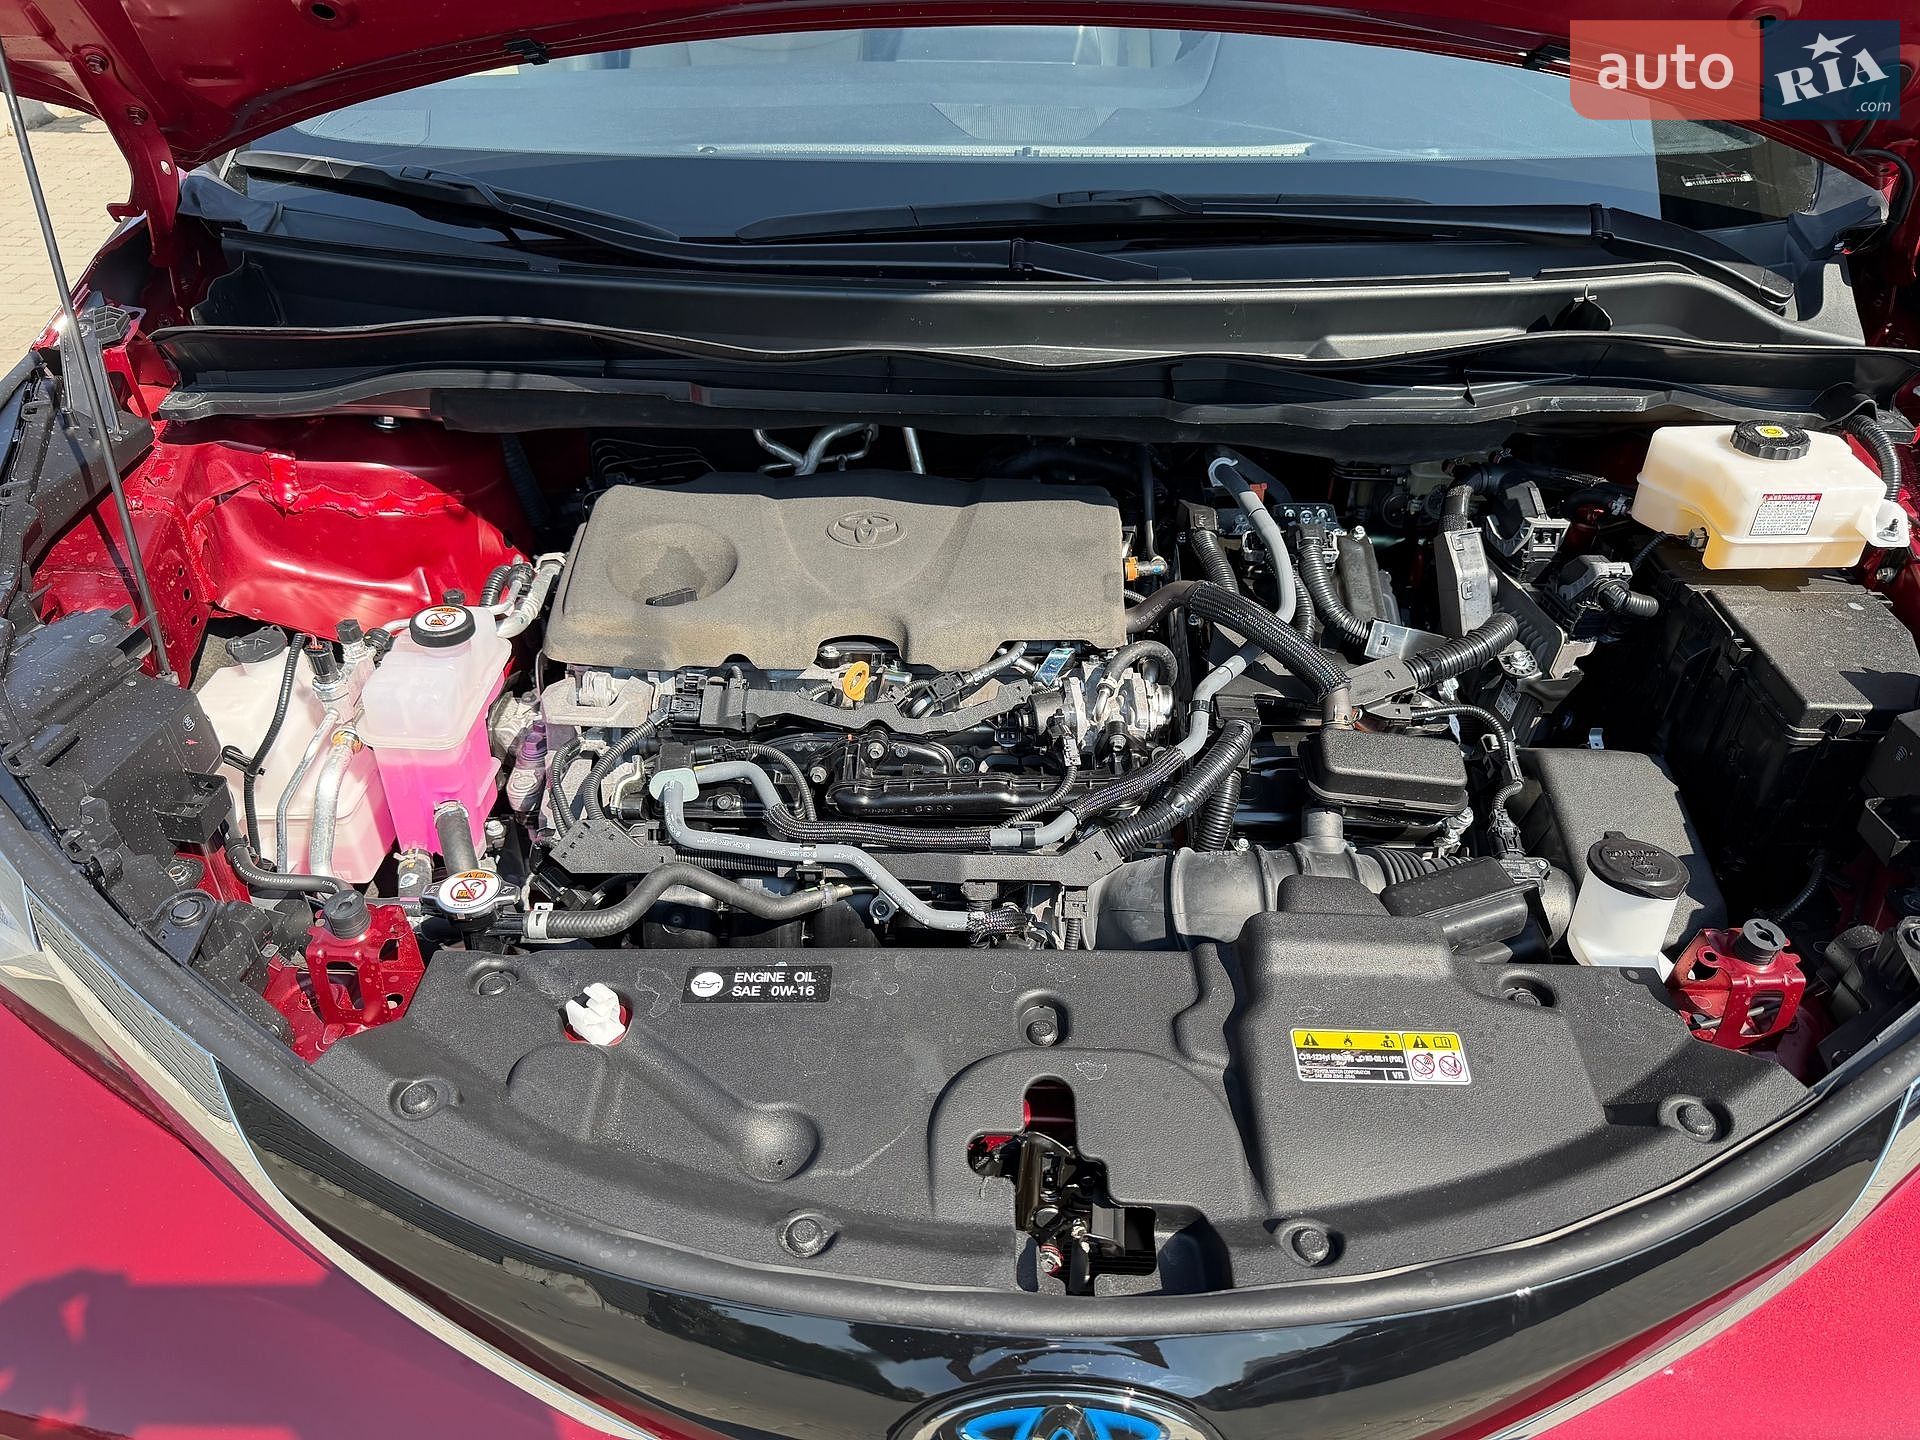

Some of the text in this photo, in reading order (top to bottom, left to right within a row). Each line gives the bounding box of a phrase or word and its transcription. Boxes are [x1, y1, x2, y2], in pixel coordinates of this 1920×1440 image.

[734, 972, 817, 983] ENGINE OIL
[731, 985, 815, 997] SAE 0W-16
